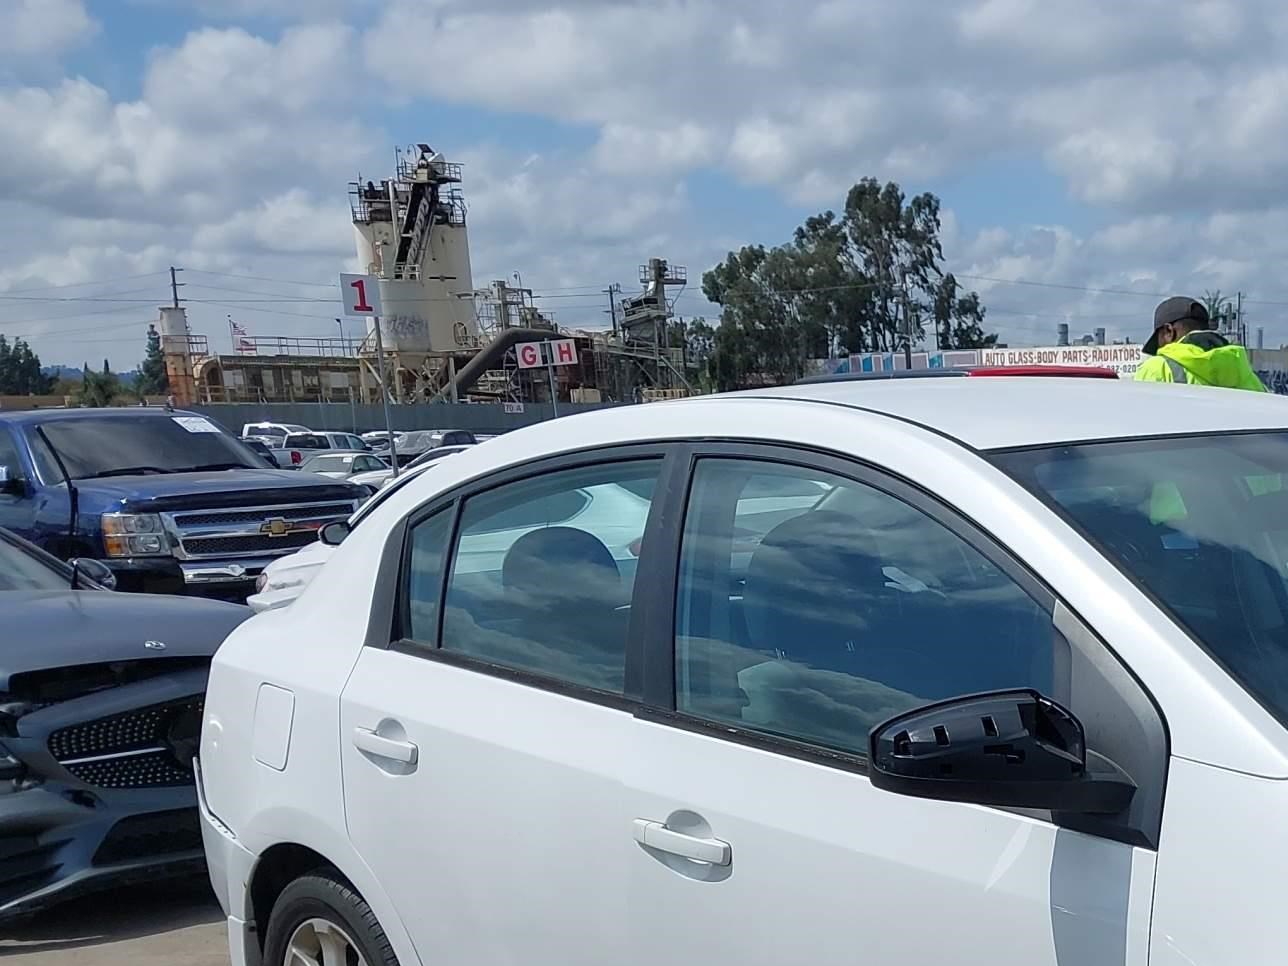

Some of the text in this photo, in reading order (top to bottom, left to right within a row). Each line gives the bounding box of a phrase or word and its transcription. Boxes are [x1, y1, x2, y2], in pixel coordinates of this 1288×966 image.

[350, 279, 373, 312] 1
[522, 345, 537, 366] G
[557, 343, 573, 362] H
[985, 350, 1006, 367] AUTO
